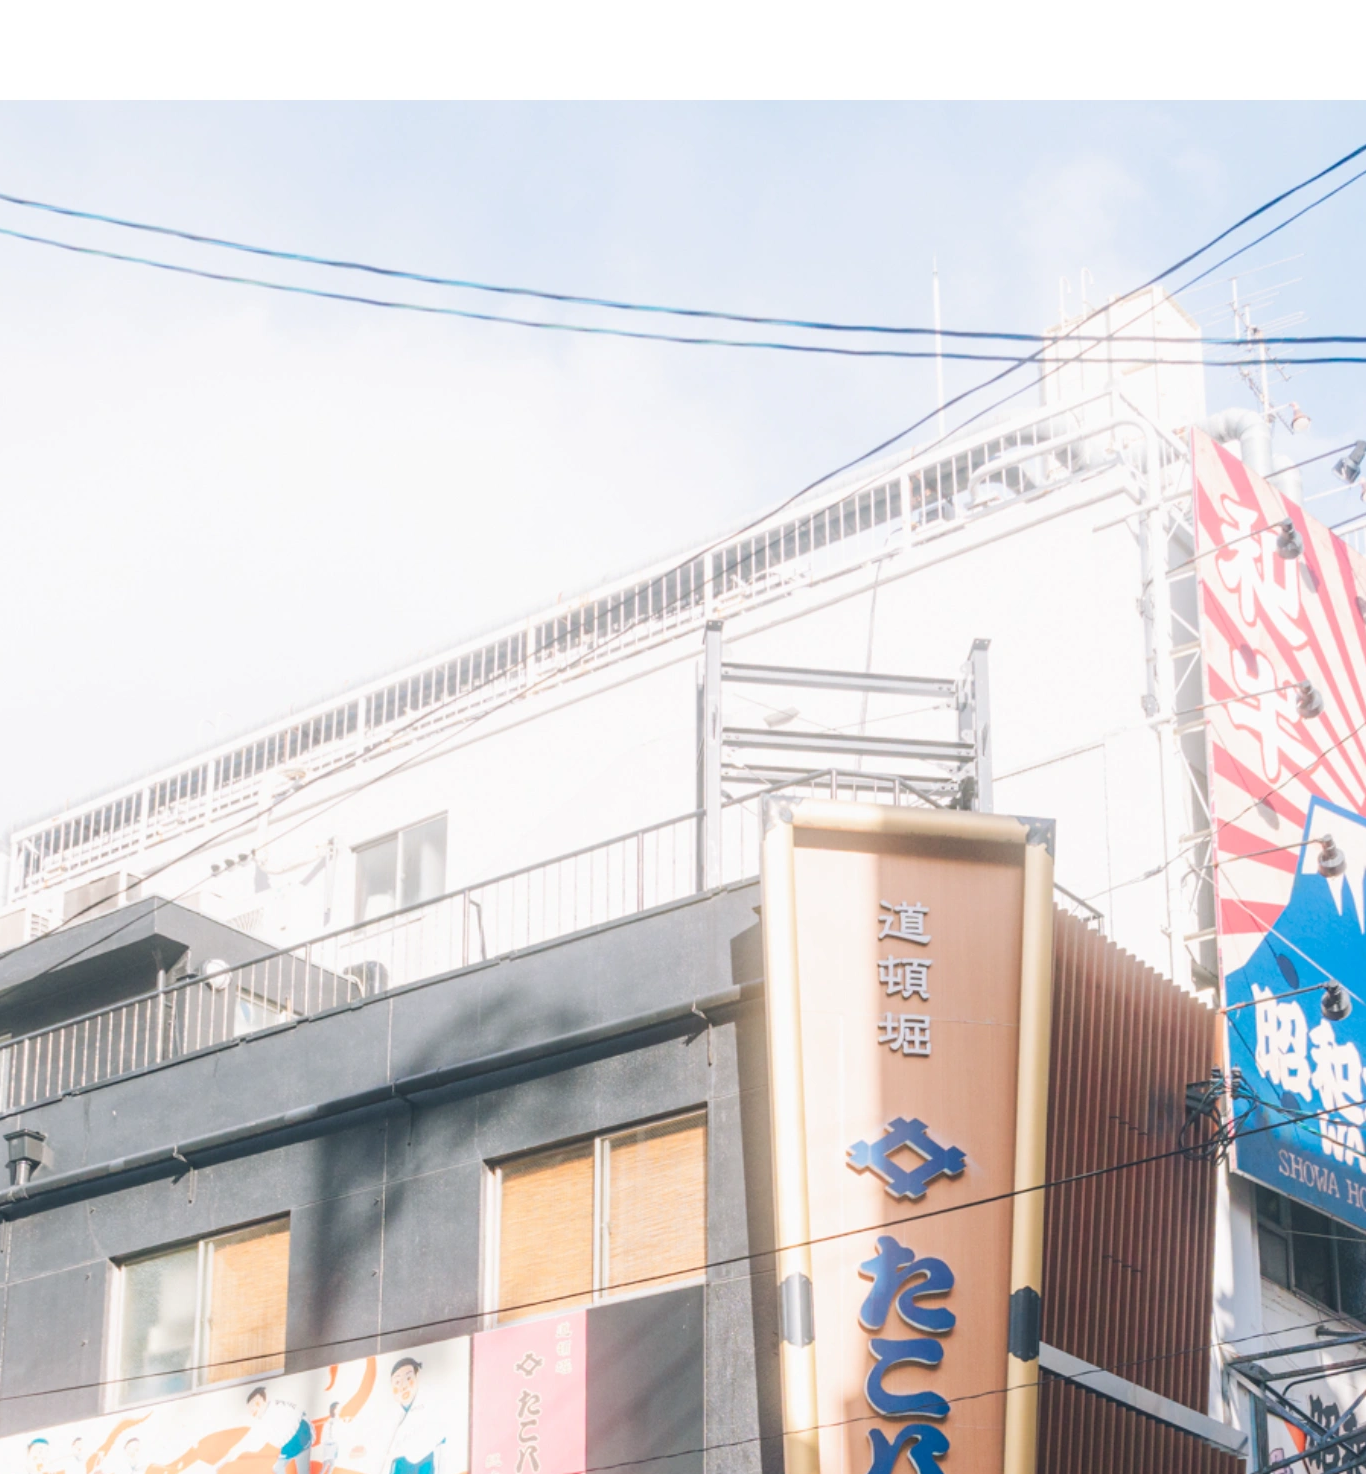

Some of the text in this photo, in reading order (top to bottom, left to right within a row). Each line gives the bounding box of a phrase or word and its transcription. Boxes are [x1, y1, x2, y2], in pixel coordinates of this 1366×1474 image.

[876, 898, 934, 1059] 道頓堀
[1278, 1149, 1340, 1198] SHOWA
